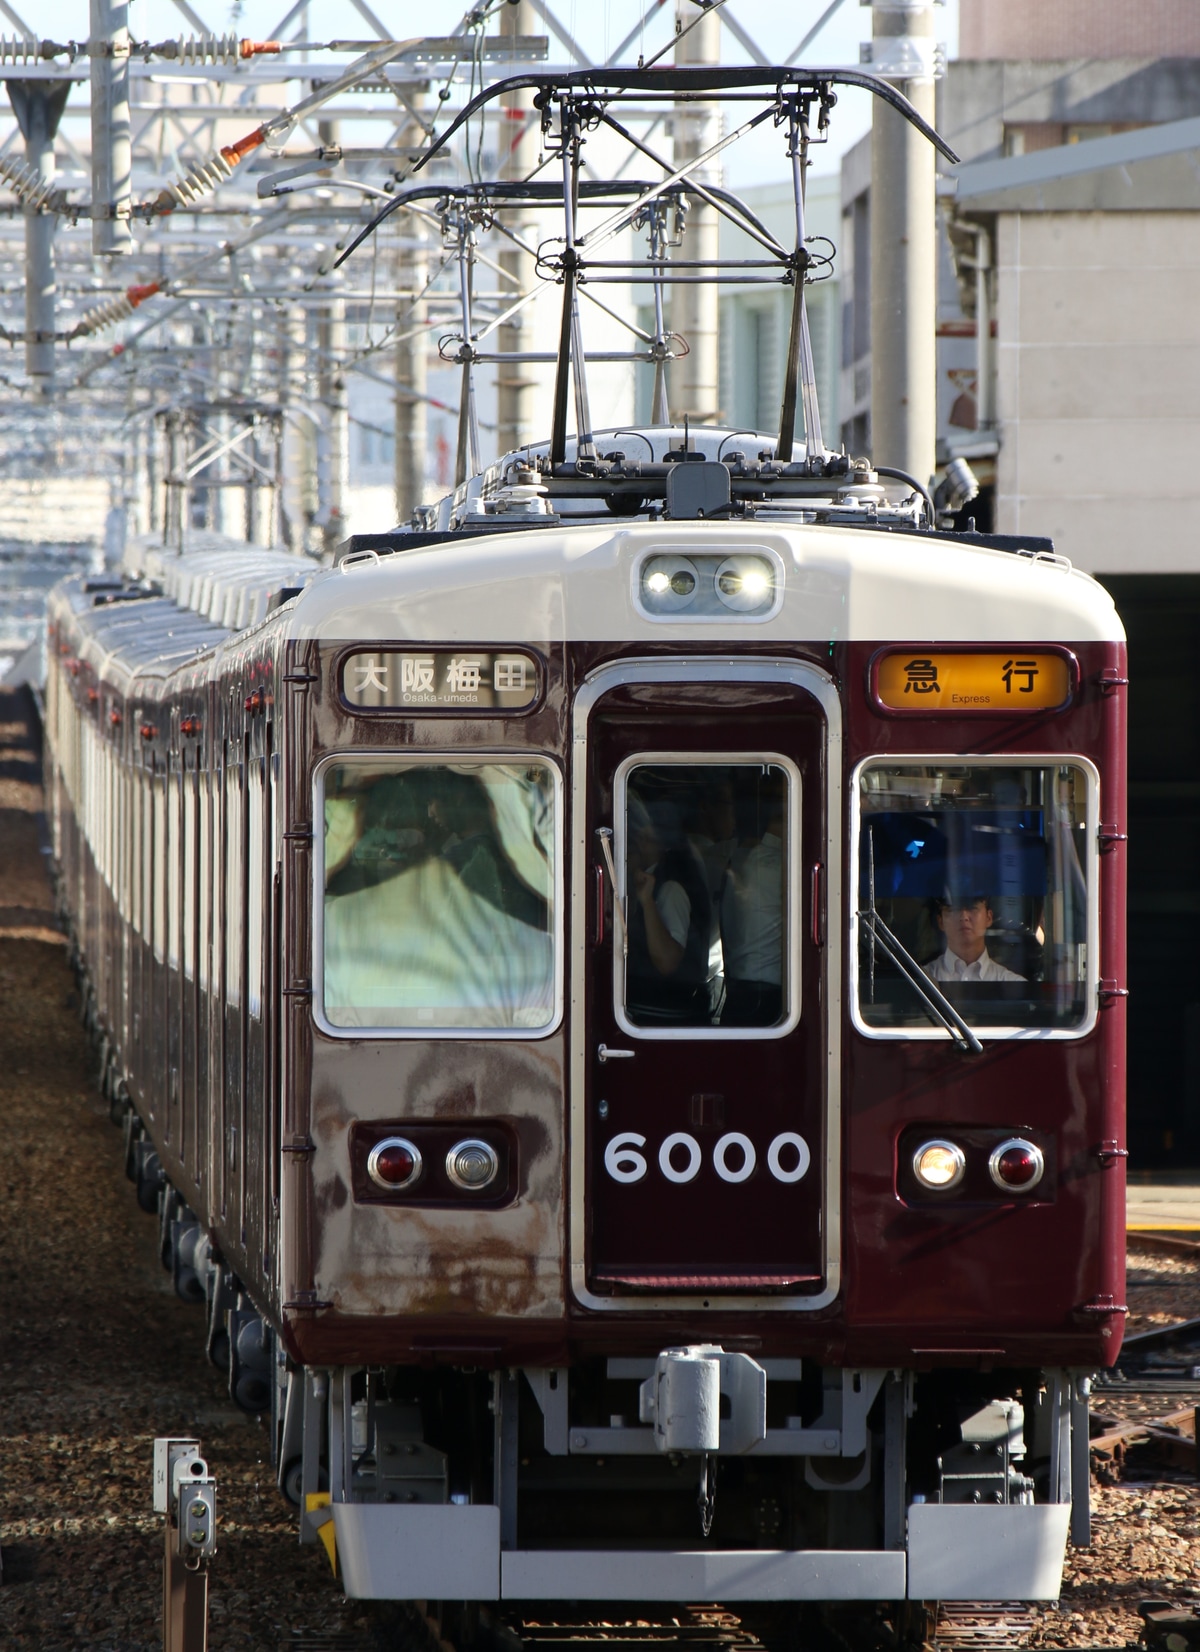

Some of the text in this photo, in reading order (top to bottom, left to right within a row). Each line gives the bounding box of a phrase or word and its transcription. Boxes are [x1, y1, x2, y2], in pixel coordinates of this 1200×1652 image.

[354, 658, 526, 692] 大阪梅田
[904, 659, 1039, 693] 急行
[403, 692, 478, 702] Osaka-umeda
[952, 694, 990, 704] Express
[604, 1132, 810, 1183] 6000
